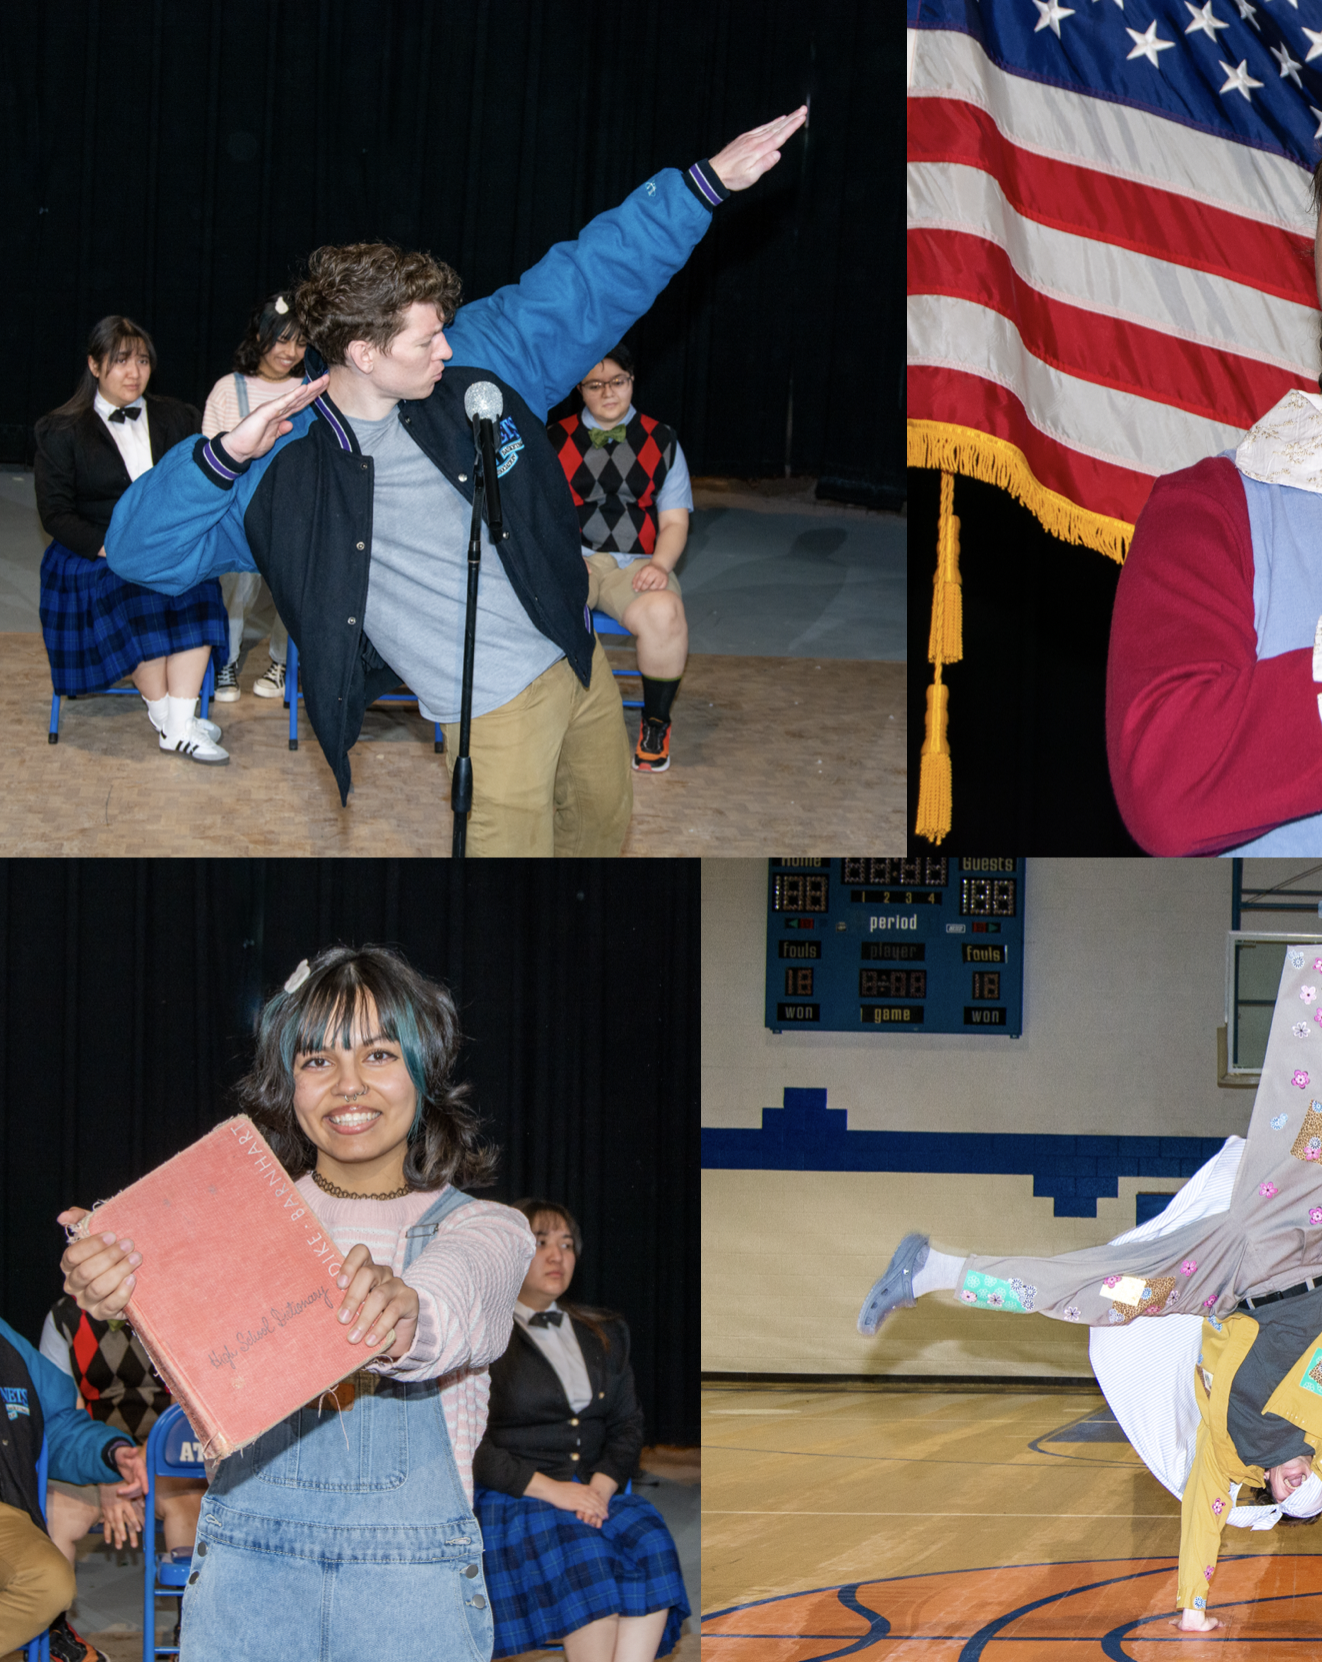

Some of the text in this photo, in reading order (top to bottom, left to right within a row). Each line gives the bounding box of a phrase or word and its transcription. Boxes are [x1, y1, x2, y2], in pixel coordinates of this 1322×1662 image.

[963, 857, 1013, 872] Guests
[883, 891, 890, 904] 2
[906, 892, 912, 904] 3
[928, 892, 935, 904] 4
[869, 913, 918, 933] period
[783, 941, 817, 958] fouls
[870, 942, 917, 960] player
[966, 945, 1001, 962] fouls
[785, 1006, 813, 1019] won
[874, 1008, 911, 1024] game
[972, 1010, 999, 1023] won
[230, 1123, 305, 1221] BARNHART
[307, 1232, 343, 1277] DIKE
[208, 1286, 334, 1370] High School Dictionary
